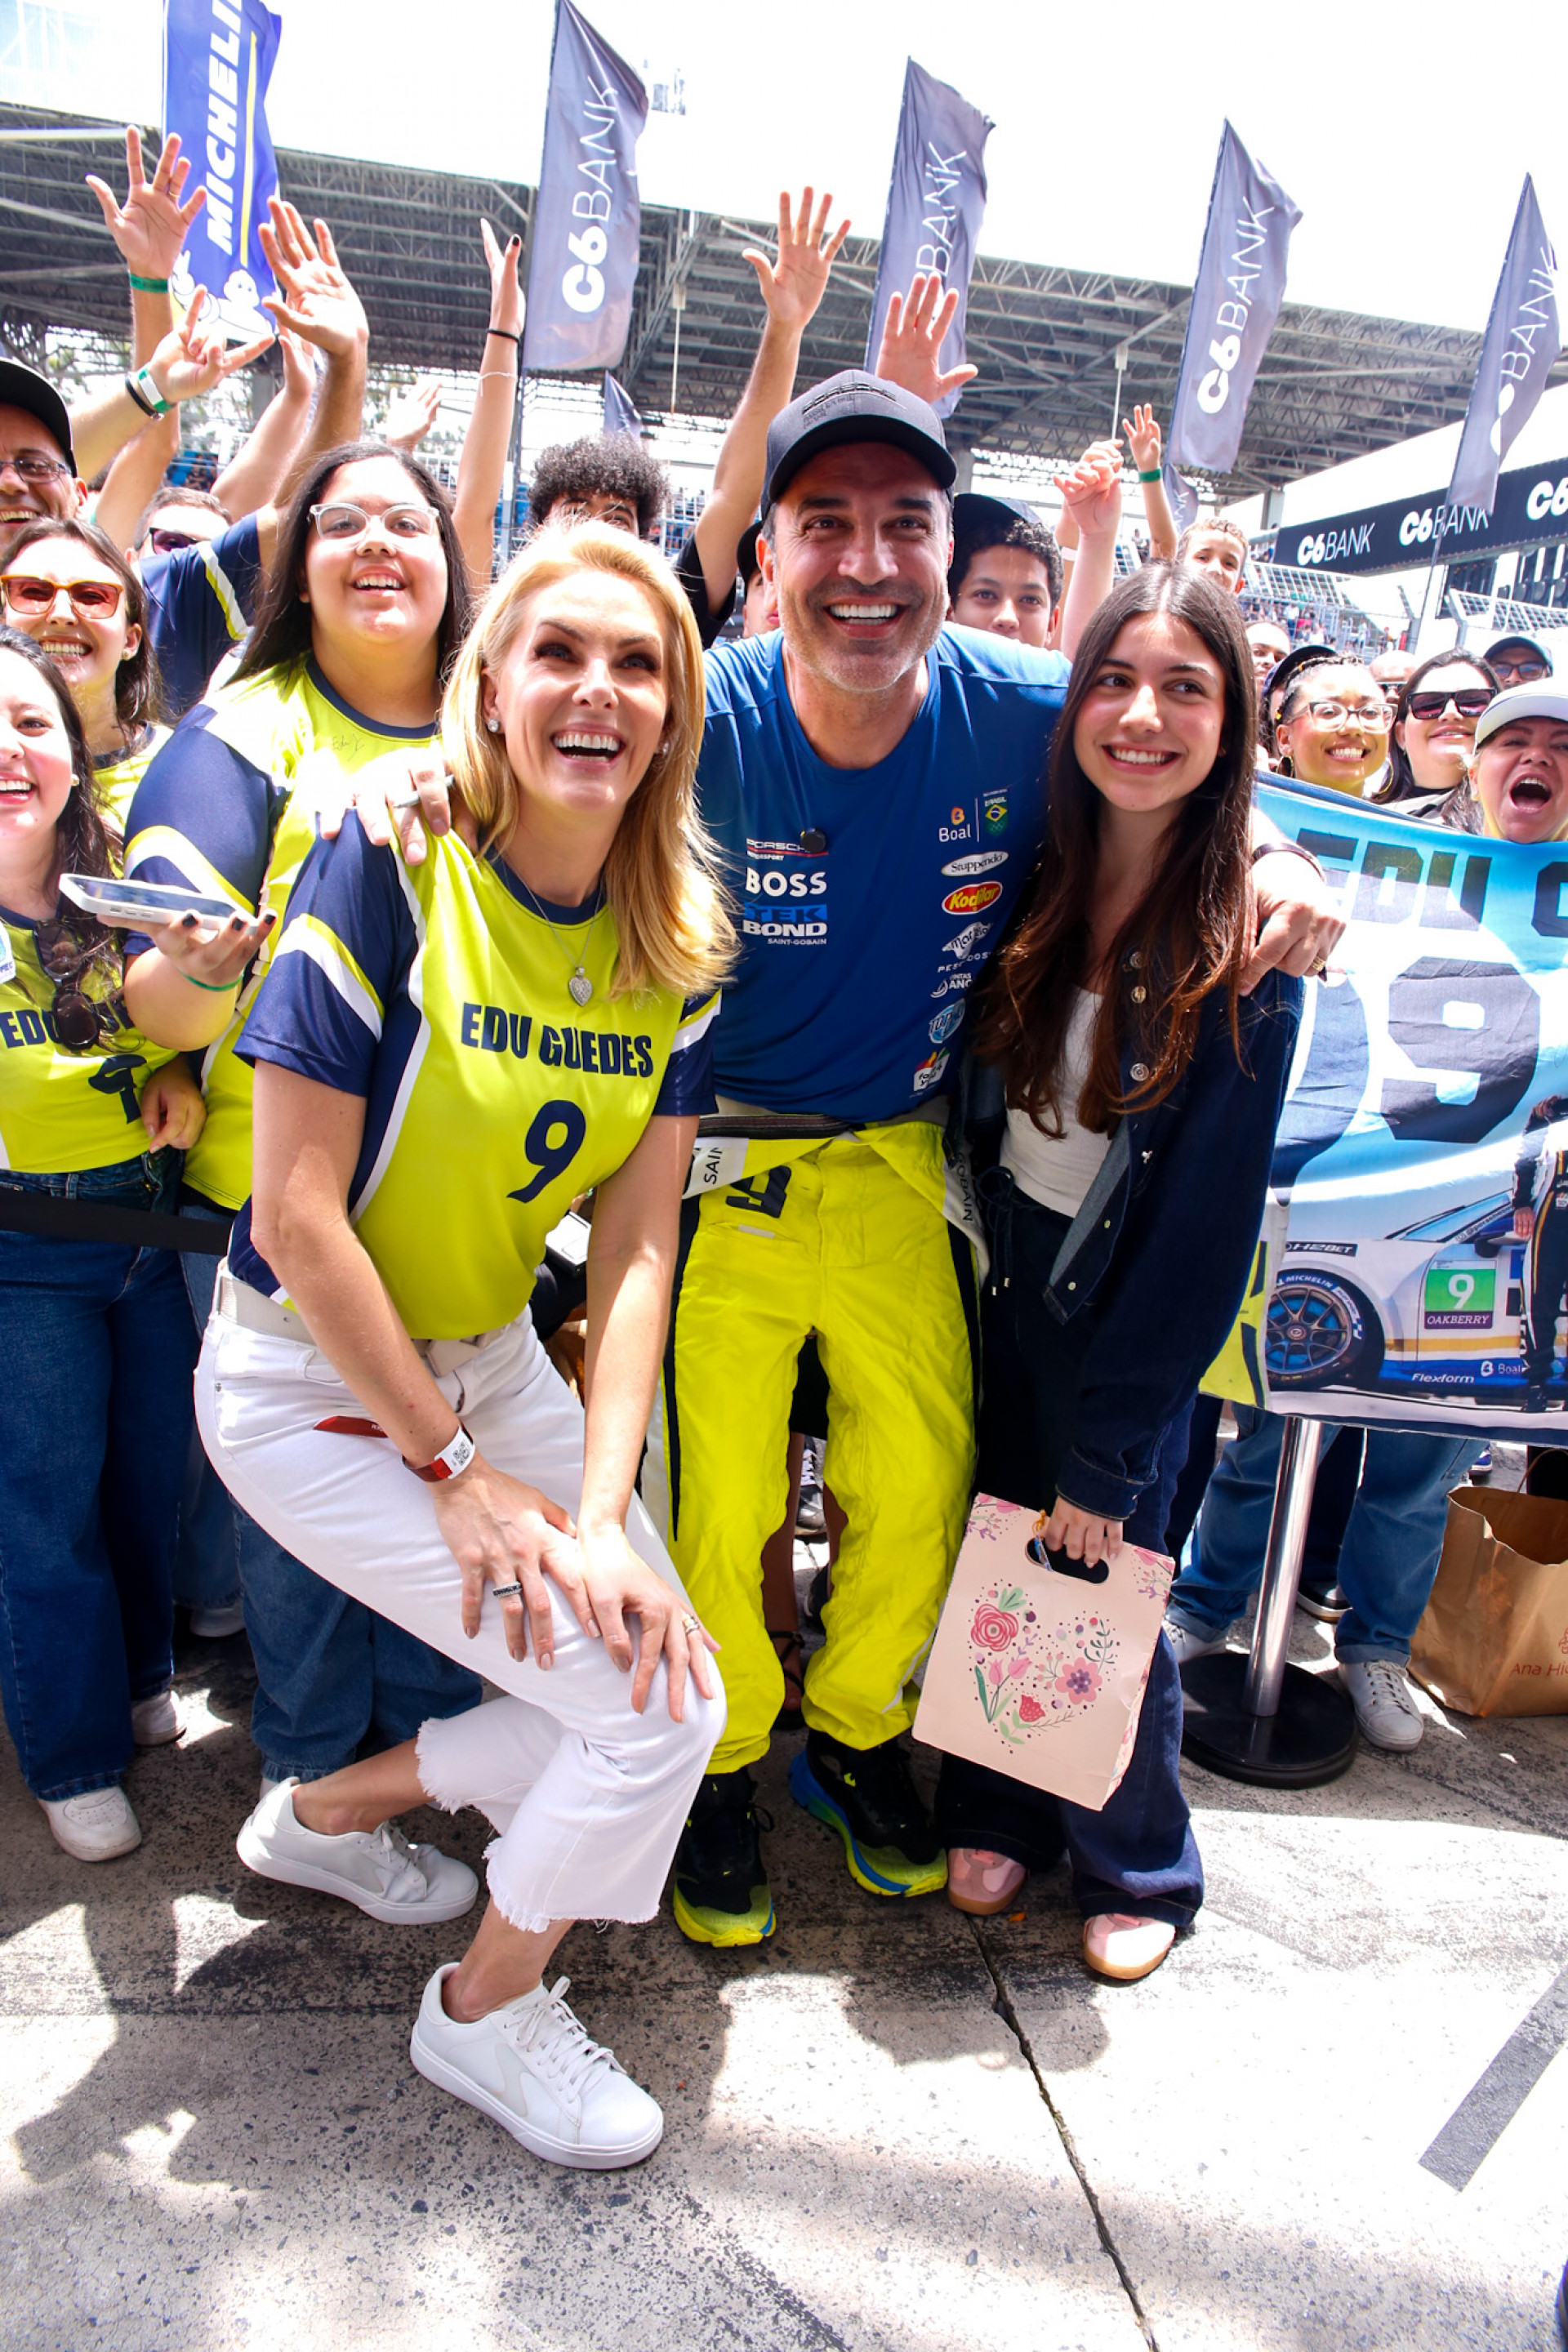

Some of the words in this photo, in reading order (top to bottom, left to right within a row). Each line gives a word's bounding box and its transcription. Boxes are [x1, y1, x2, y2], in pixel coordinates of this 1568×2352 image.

[206, 0, 243, 256] MICHELI
[939, 823, 971, 842] Boal
[746, 866, 827, 898] BOSS
[746, 905, 823, 924] TEK
[742, 919, 827, 937] BOND
[461, 1003, 530, 1060] EDU
[539, 1025, 654, 1078] GUEDES
[1379, 956, 1541, 1144] 9
[506, 1099, 587, 1204] 9
[1285, 1274, 1334, 1289] MICHELIN
[1448, 1273, 1475, 1310] 9
[1427, 1315, 1490, 1325] OAKBERRY
[1411, 1373, 1475, 1384] Flexform
[1509, 1663, 1542, 1677] Ana
